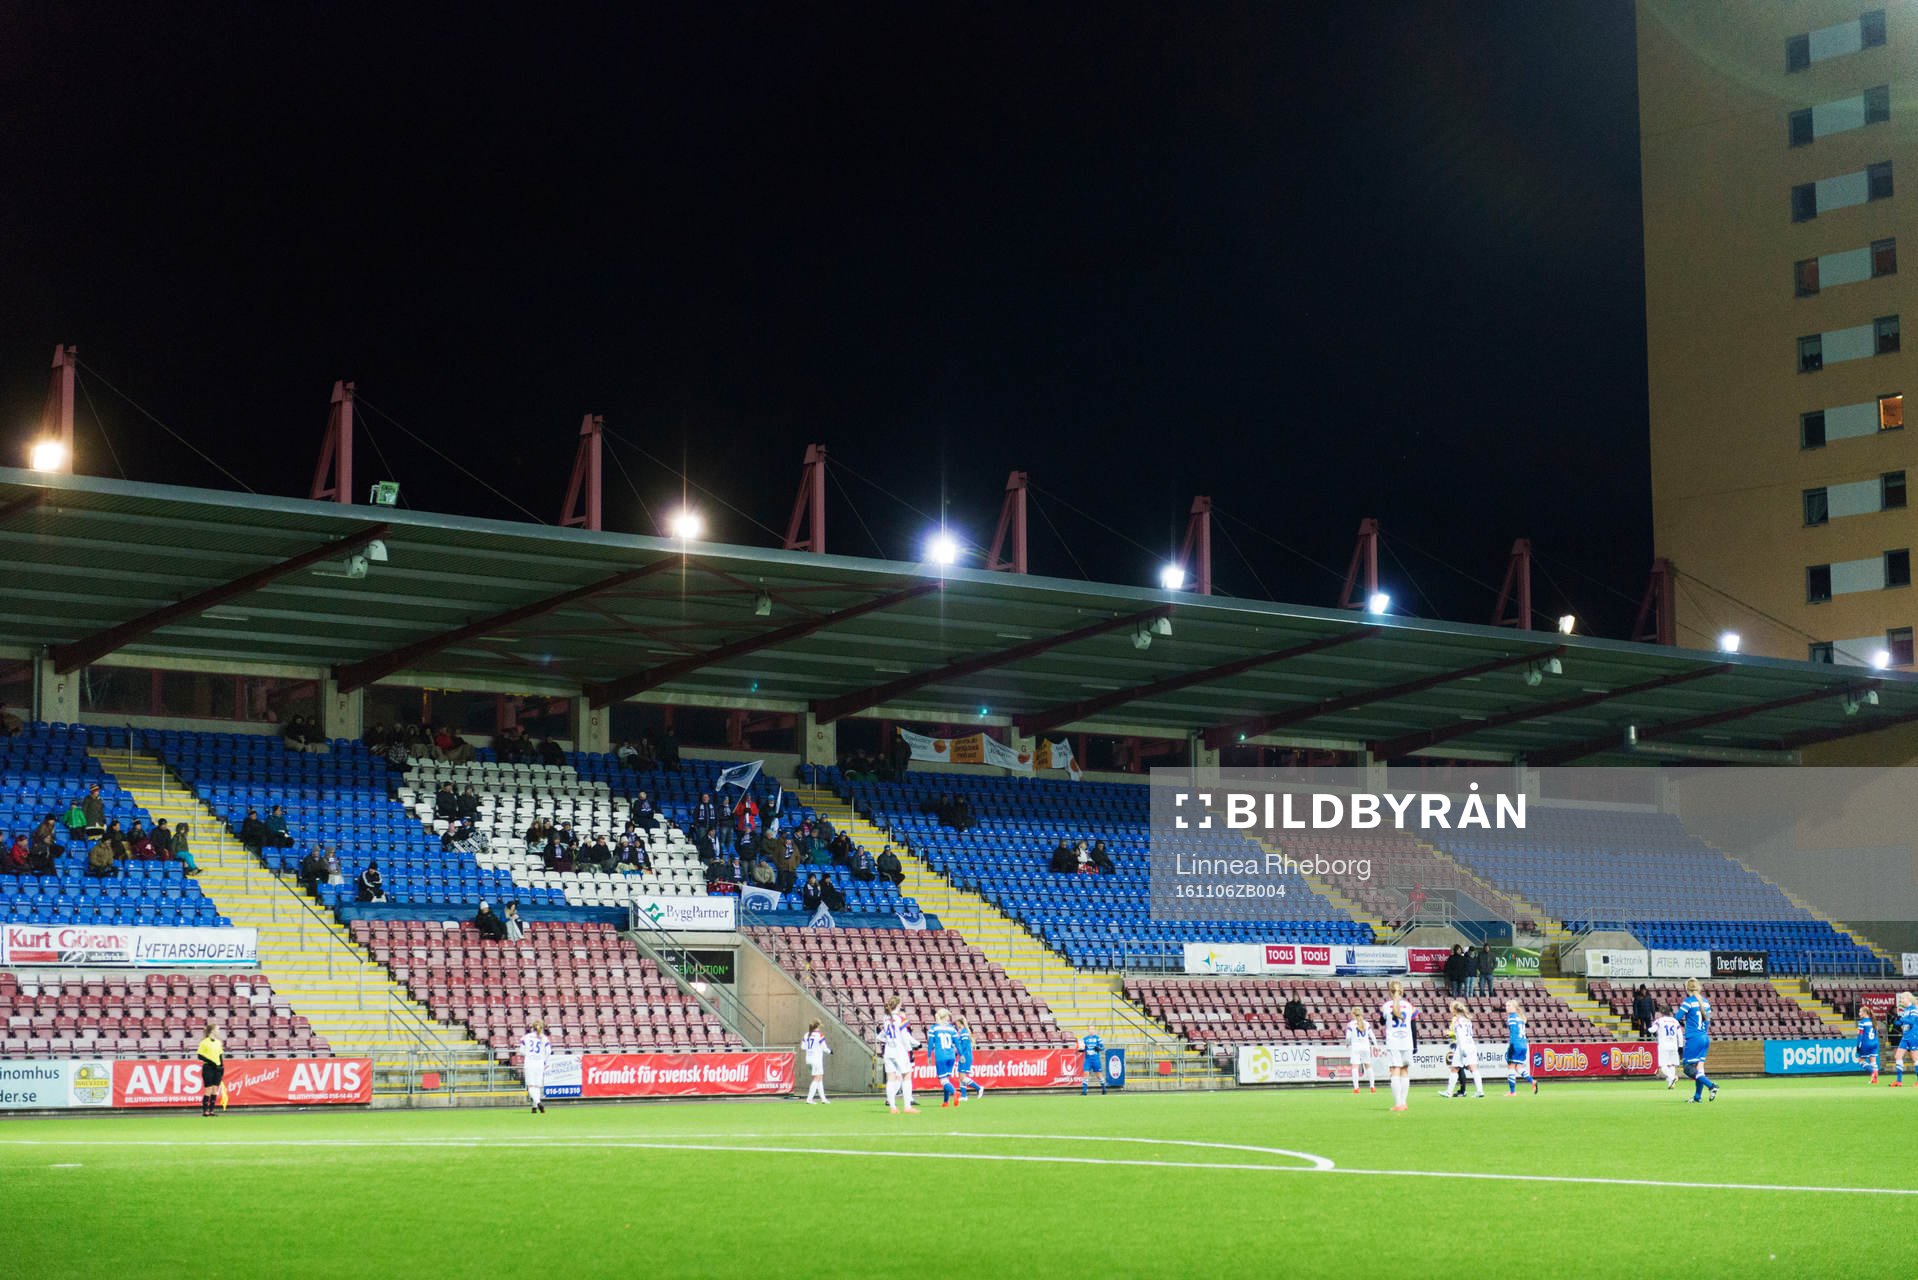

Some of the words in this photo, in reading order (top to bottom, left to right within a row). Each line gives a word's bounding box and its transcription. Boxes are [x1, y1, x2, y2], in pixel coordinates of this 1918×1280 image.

[666, 905, 729, 922] ByggPartner
[9, 929, 51, 948] Kurt
[58, 930, 129, 948] Görans
[135, 936, 244, 958] LYFTARSHOPEN
[1268, 950, 1294, 960] TOOLS
[1302, 950, 1328, 961] TOOLS
[1516, 957, 1540, 968] INVID
[1656, 956, 1680, 968] ATEA
[1684, 956, 1708, 968] ATEA
[1663, 1024, 1675, 1036] 16
[1868, 1027, 1875, 1040] 6
[529, 1039, 541, 1054] 35
[937, 1032, 952, 1050] 10
[1290, 1048, 1311, 1062] VVS
[1412, 1055, 1444, 1063] SPORTIVE
[1544, 1048, 1588, 1071] Dumle
[1611, 1047, 1653, 1070] Dumle
[244, 1067, 280, 1088] harder!
[288, 1062, 361, 1092] AVIS
[587, 1065, 636, 1085] Framåt
[636, 1065, 657, 1084] för
[658, 1065, 701, 1084] svensk
[702, 1064, 749, 1083] fotboll!
[969, 1061, 1006, 1078] svensk
[1007, 1060, 1048, 1077] fotboll!
[125, 1064, 202, 1095] AVIS
